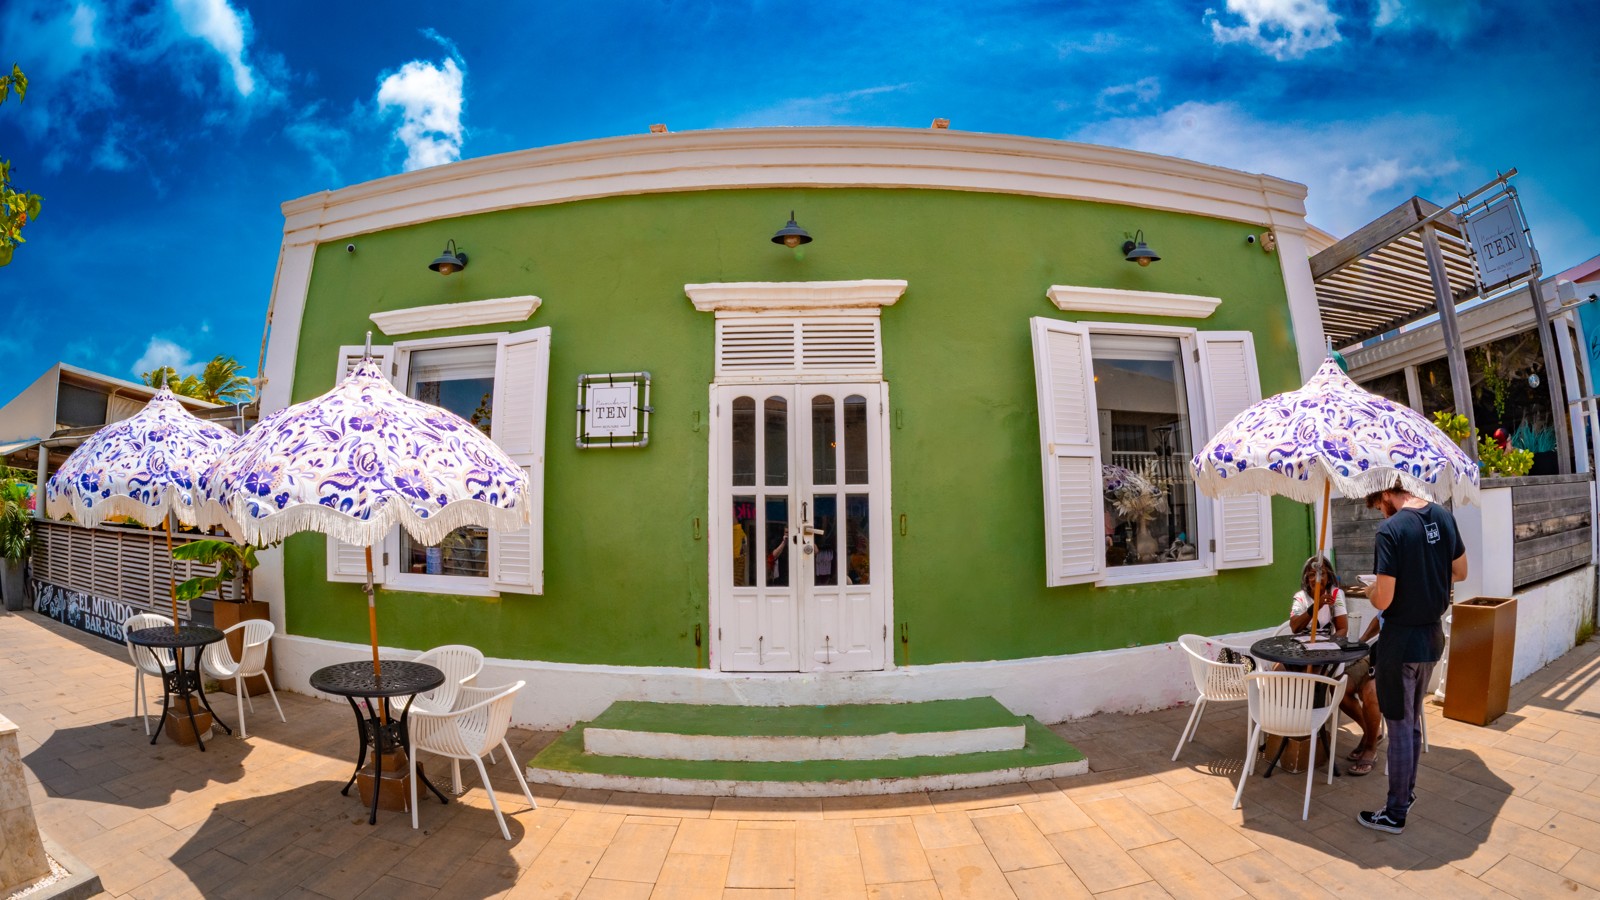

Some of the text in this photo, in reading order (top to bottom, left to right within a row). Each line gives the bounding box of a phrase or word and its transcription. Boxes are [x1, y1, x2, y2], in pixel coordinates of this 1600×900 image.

[1483, 232, 1517, 260] TEN
[595, 406, 628, 419] TEN
[79, 592, 134, 624] EL MUNDO
[84, 614, 127, 641] BAR-RES
